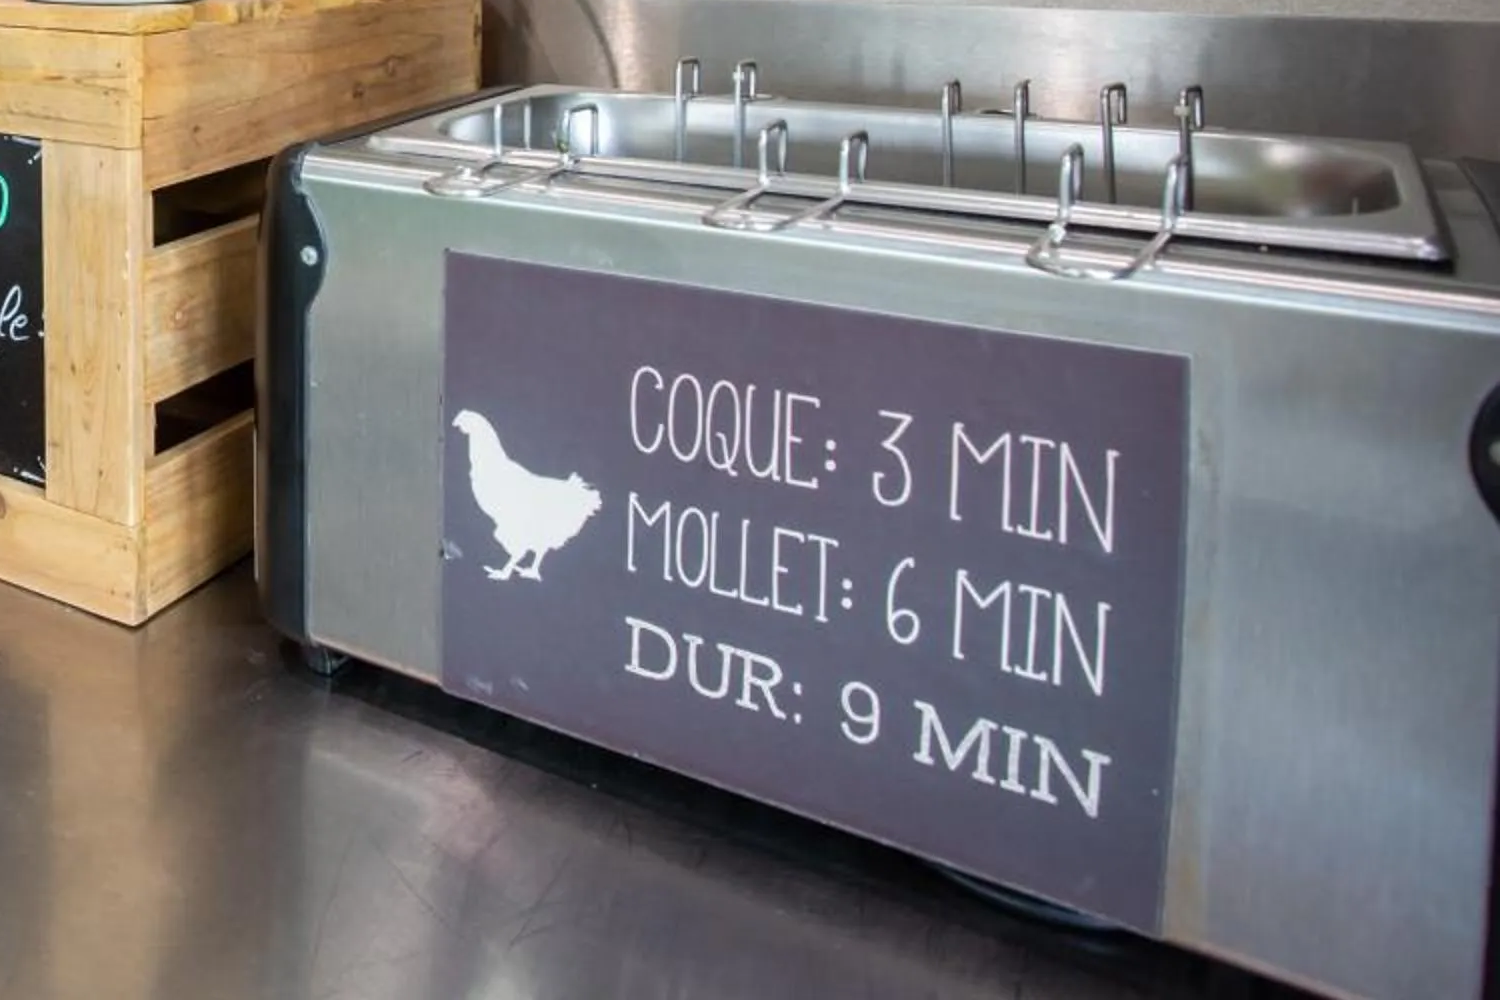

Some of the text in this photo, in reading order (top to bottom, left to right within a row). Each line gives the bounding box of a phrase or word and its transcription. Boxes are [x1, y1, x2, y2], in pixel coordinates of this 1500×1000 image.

[630, 365, 1121, 554] COQUE: 3 MIN
[627, 491, 1113, 697] MOLLET: 6 MIN
[624, 616, 1113, 819] DUR: 9 MIN
